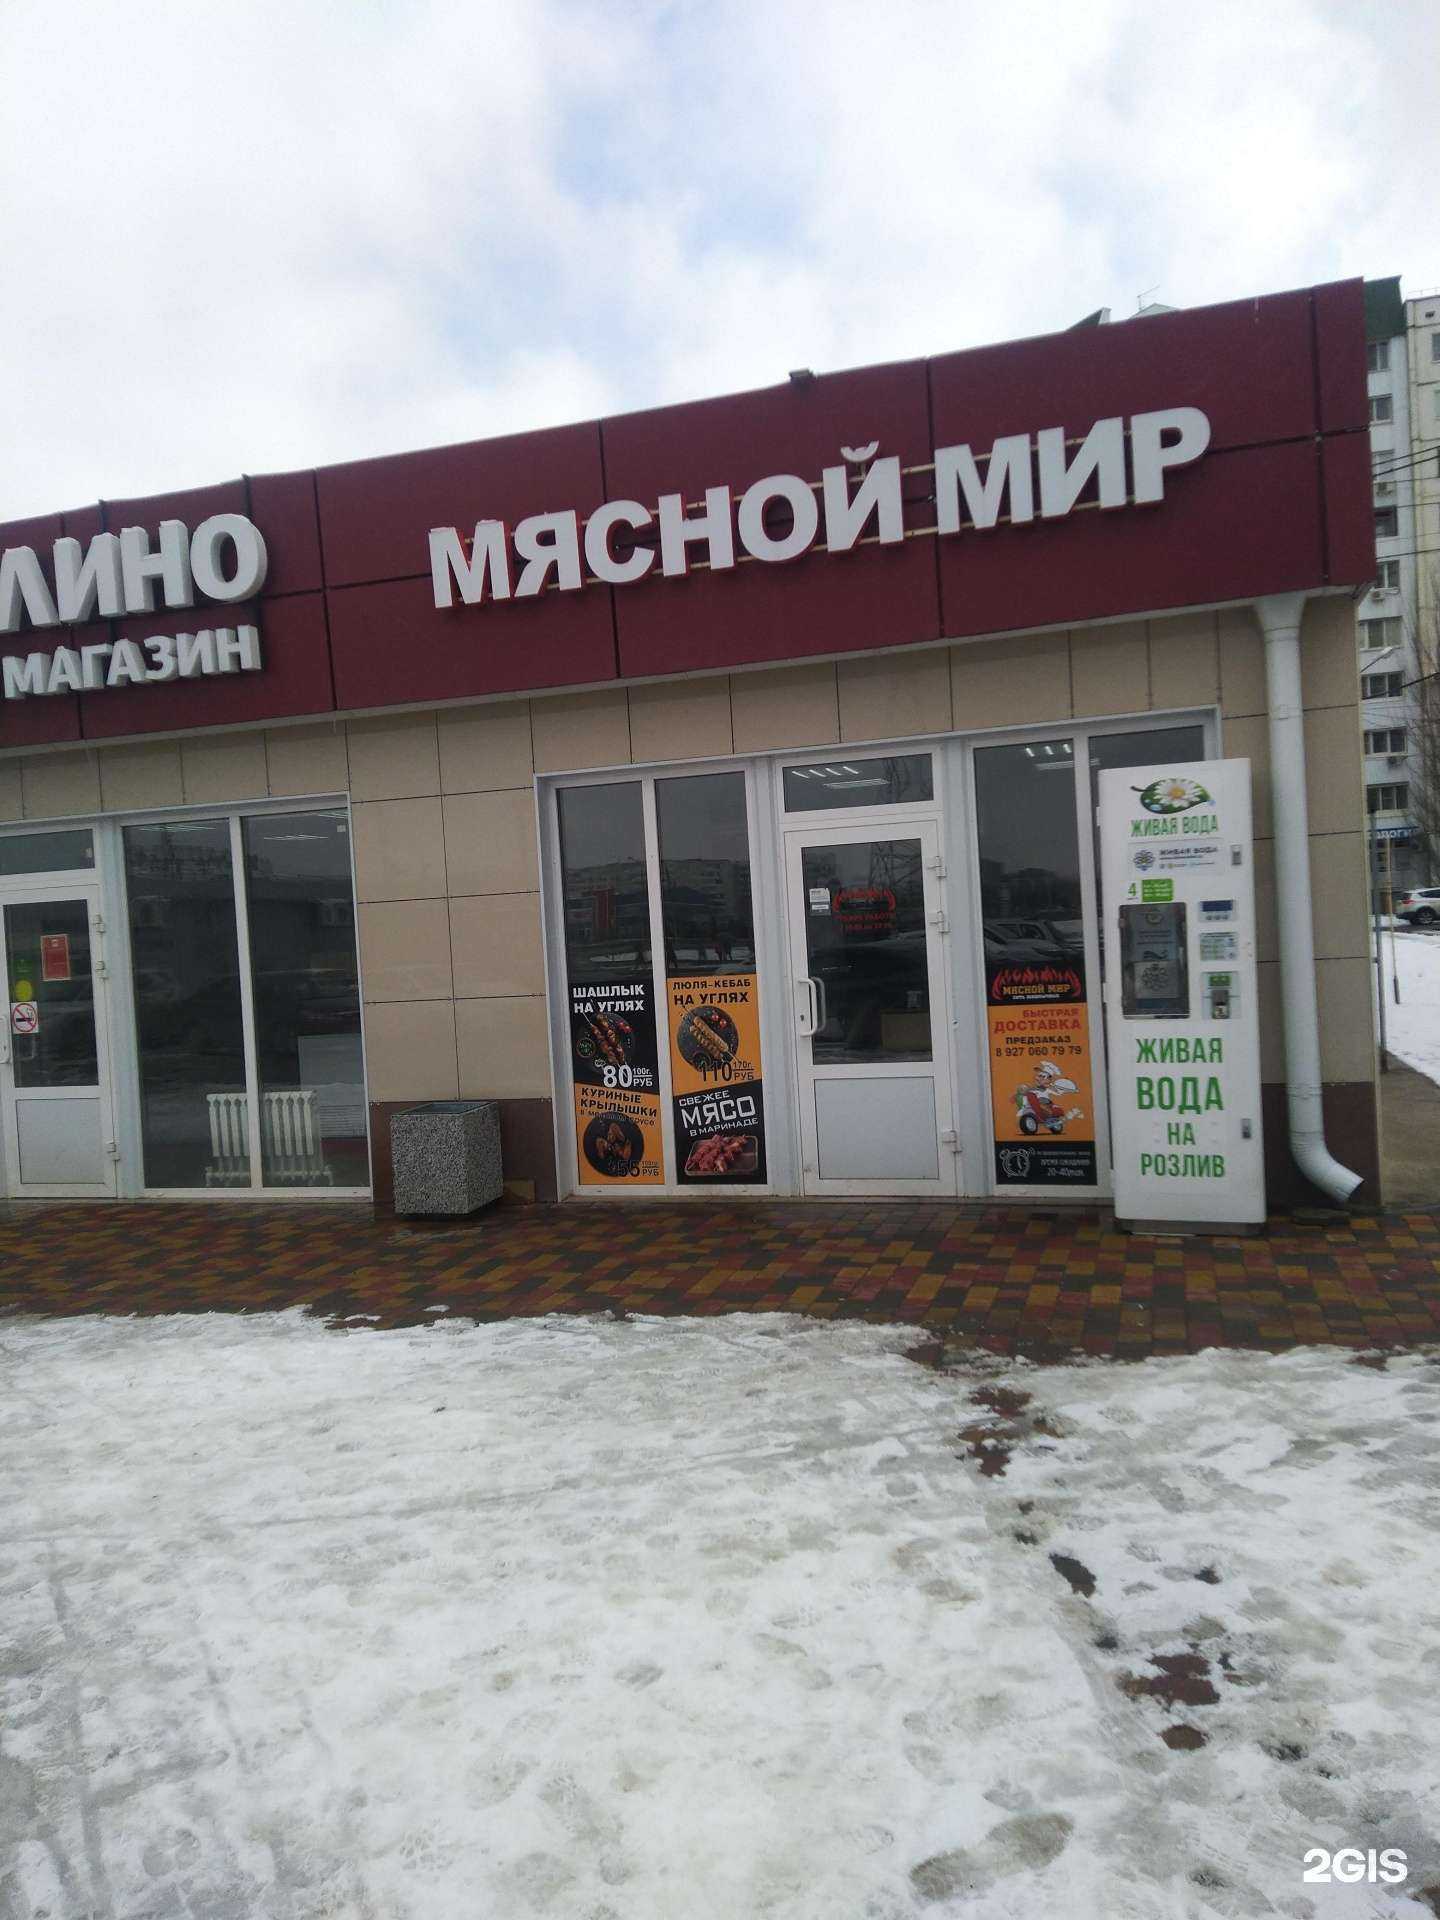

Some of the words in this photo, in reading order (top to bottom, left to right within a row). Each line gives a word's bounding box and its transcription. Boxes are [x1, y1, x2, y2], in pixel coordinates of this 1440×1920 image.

[428, 440, 905, 609] МЯСНОЙ
[933, 405, 1212, 536] МИР
[0, 513, 268, 633] ЛИНО
[2, 624, 262, 700] МАГАЗИН
[1131, 817, 1177, 837] ЖИВАЯ
[1183, 815, 1218, 835] ВОДА
[573, 985, 645, 998] ШАШЛЫК
[673, 979, 751, 990] ЛЮЛЯ-КЕБАБ
[574, 1002, 594, 1013] НА
[597, 1000, 645, 1012] УГЛЯХ
[674, 994, 694, 1005] НА
[699, 992, 750, 1004] УГЛЯХ
[1023, 1008, 1079, 1018] БЫСТРАЯ
[994, 1019, 1081, 1034] ДОСТАВКА
[1005, 1035, 1071, 1045] ПРЕДЗАКАЗ
[996, 1048, 1002, 1057] 8
[1005, 1047, 1024, 1057] 927
[1051, 1046, 1065, 1056] 79
[1068, 1045, 1082, 1055] 79
[1136, 1037, 1223, 1064] ЖИВАЯ
[603, 1065, 632, 1088] 80
[633, 1077, 653, 1087] РУБ
[734, 1071, 754, 1081] РУБ
[581, 1087, 641, 1104] КУРИНЫЕ
[679, 1089, 730, 1107] СВЕЖЕЕ
[1136, 1076, 1224, 1115] ВОДА
[580, 1098, 657, 1117] КРЫЛЫШКИ
[681, 1095, 756, 1129] МЯСО
[689, 1129, 697, 1137] В
[700, 1117, 759, 1135] МАРИНАДЕ
[1167, 1122, 1196, 1146] НА
[1141, 1153, 1226, 1178] РОЗЛИВ
